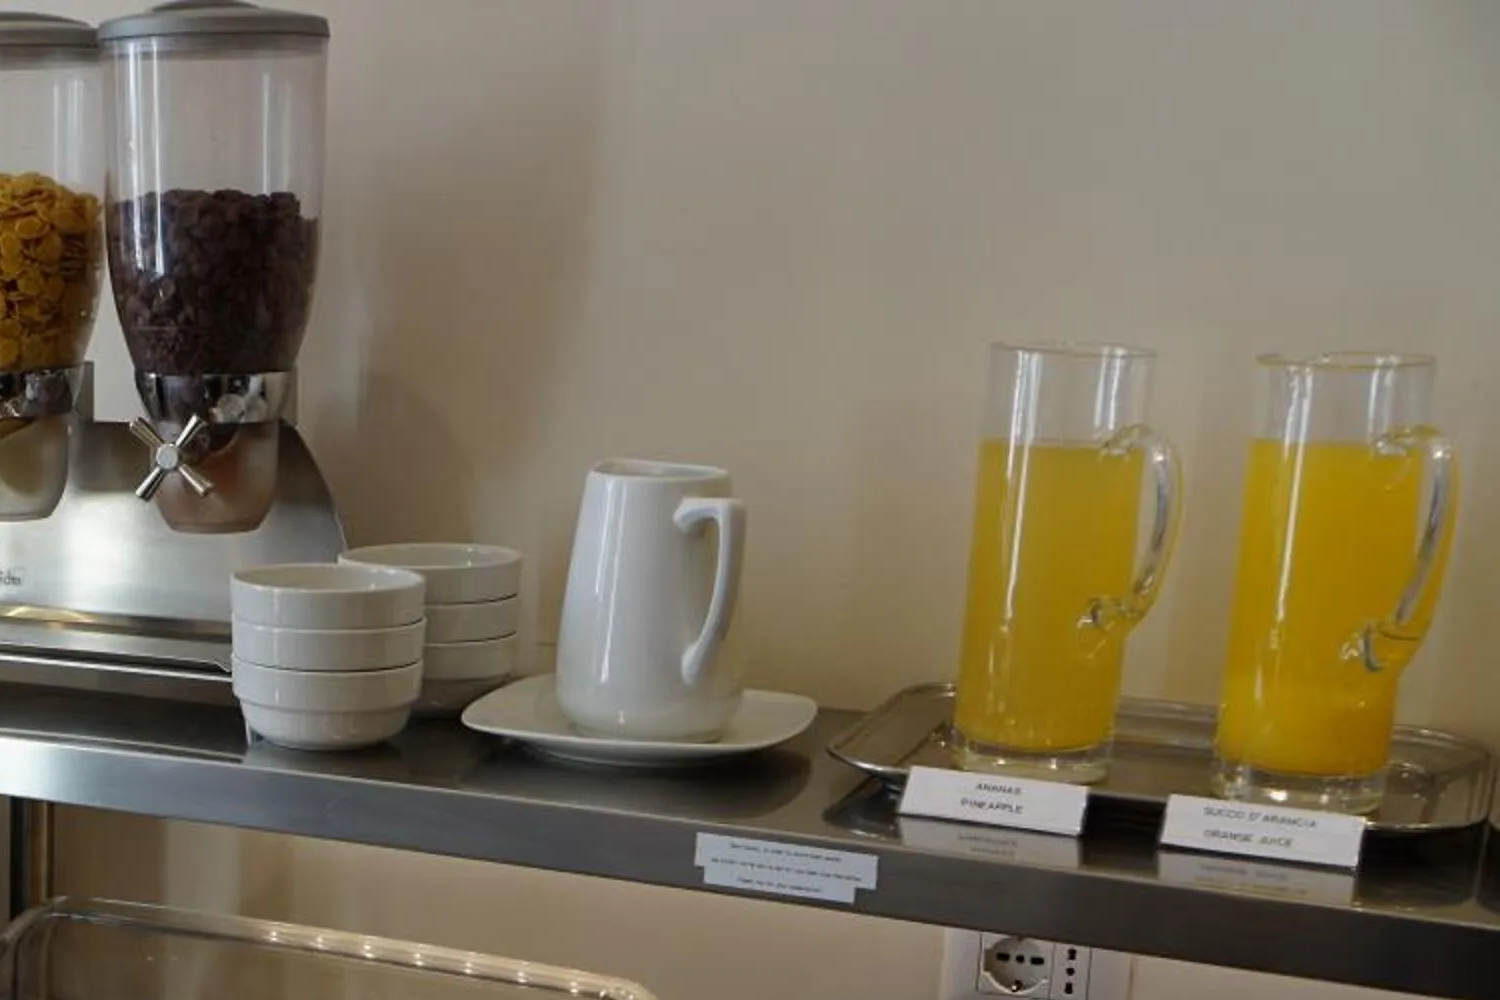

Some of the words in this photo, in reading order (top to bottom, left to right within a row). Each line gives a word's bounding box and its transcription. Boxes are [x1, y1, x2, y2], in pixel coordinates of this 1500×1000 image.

[975, 782, 1023, 795] ANANAS
[960, 797, 1025, 814] PINEAPPLE
[1203, 806, 1245, 820] SUCCO
[1203, 829, 1253, 843] ORANGE
